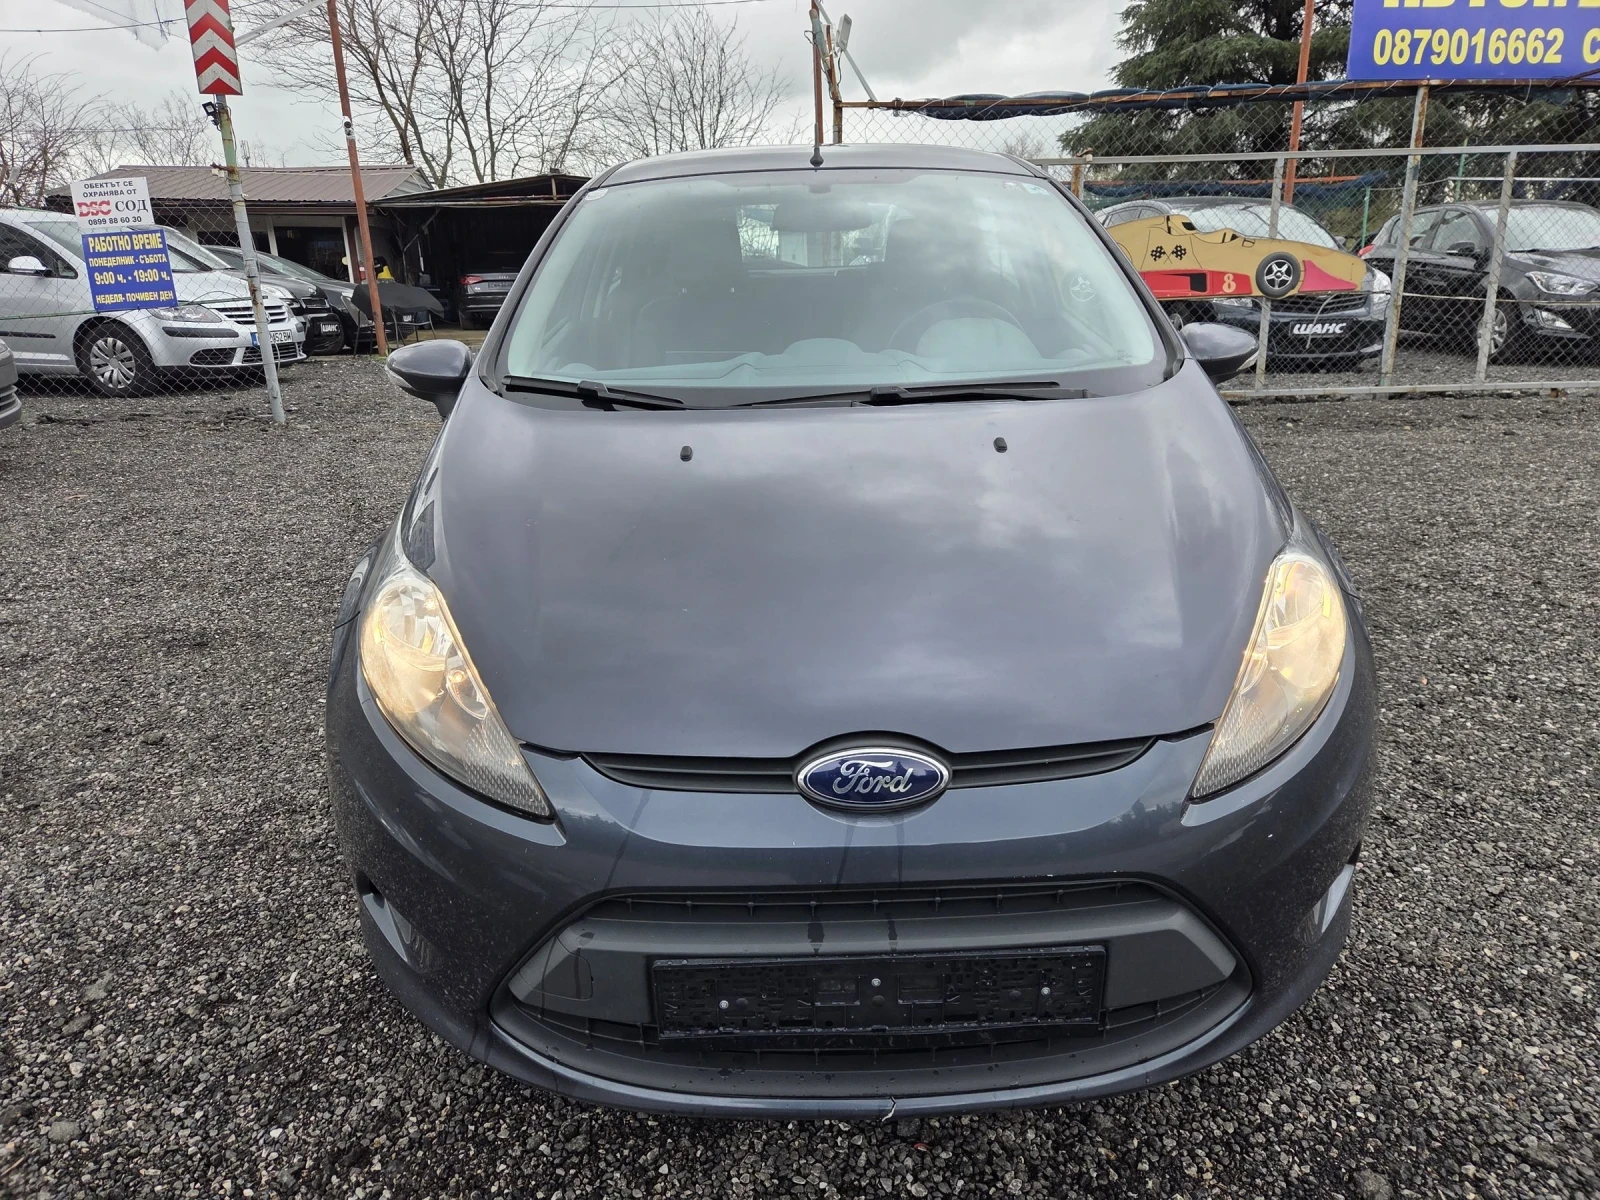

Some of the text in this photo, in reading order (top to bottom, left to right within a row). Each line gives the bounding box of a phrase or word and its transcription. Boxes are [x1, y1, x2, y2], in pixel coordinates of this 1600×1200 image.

[1373, 28, 1565, 65] 0879016662
[83, 190, 124, 198] ОХРАНЯВА
[77, 199, 149, 217] DSC СОД
[88, 218, 108, 226] 0899
[88, 232, 163, 253] РАБОТНО ВРЕМЕ
[88, 255, 135, 268] ПОНЕДЕЛНИК
[139, 253, 167, 265] СЪБОТА
[94, 271, 115, 285] 9:00
[133, 269, 159, 283] 19:00
[1222, 273, 1236, 293] 8
[126, 291, 159, 302] ПОЧИВЕН
[159, 290, 174, 301] ДЕН
[1293, 323, 1347, 335] ШАНС
[832, 760, 914, 794] Ford
